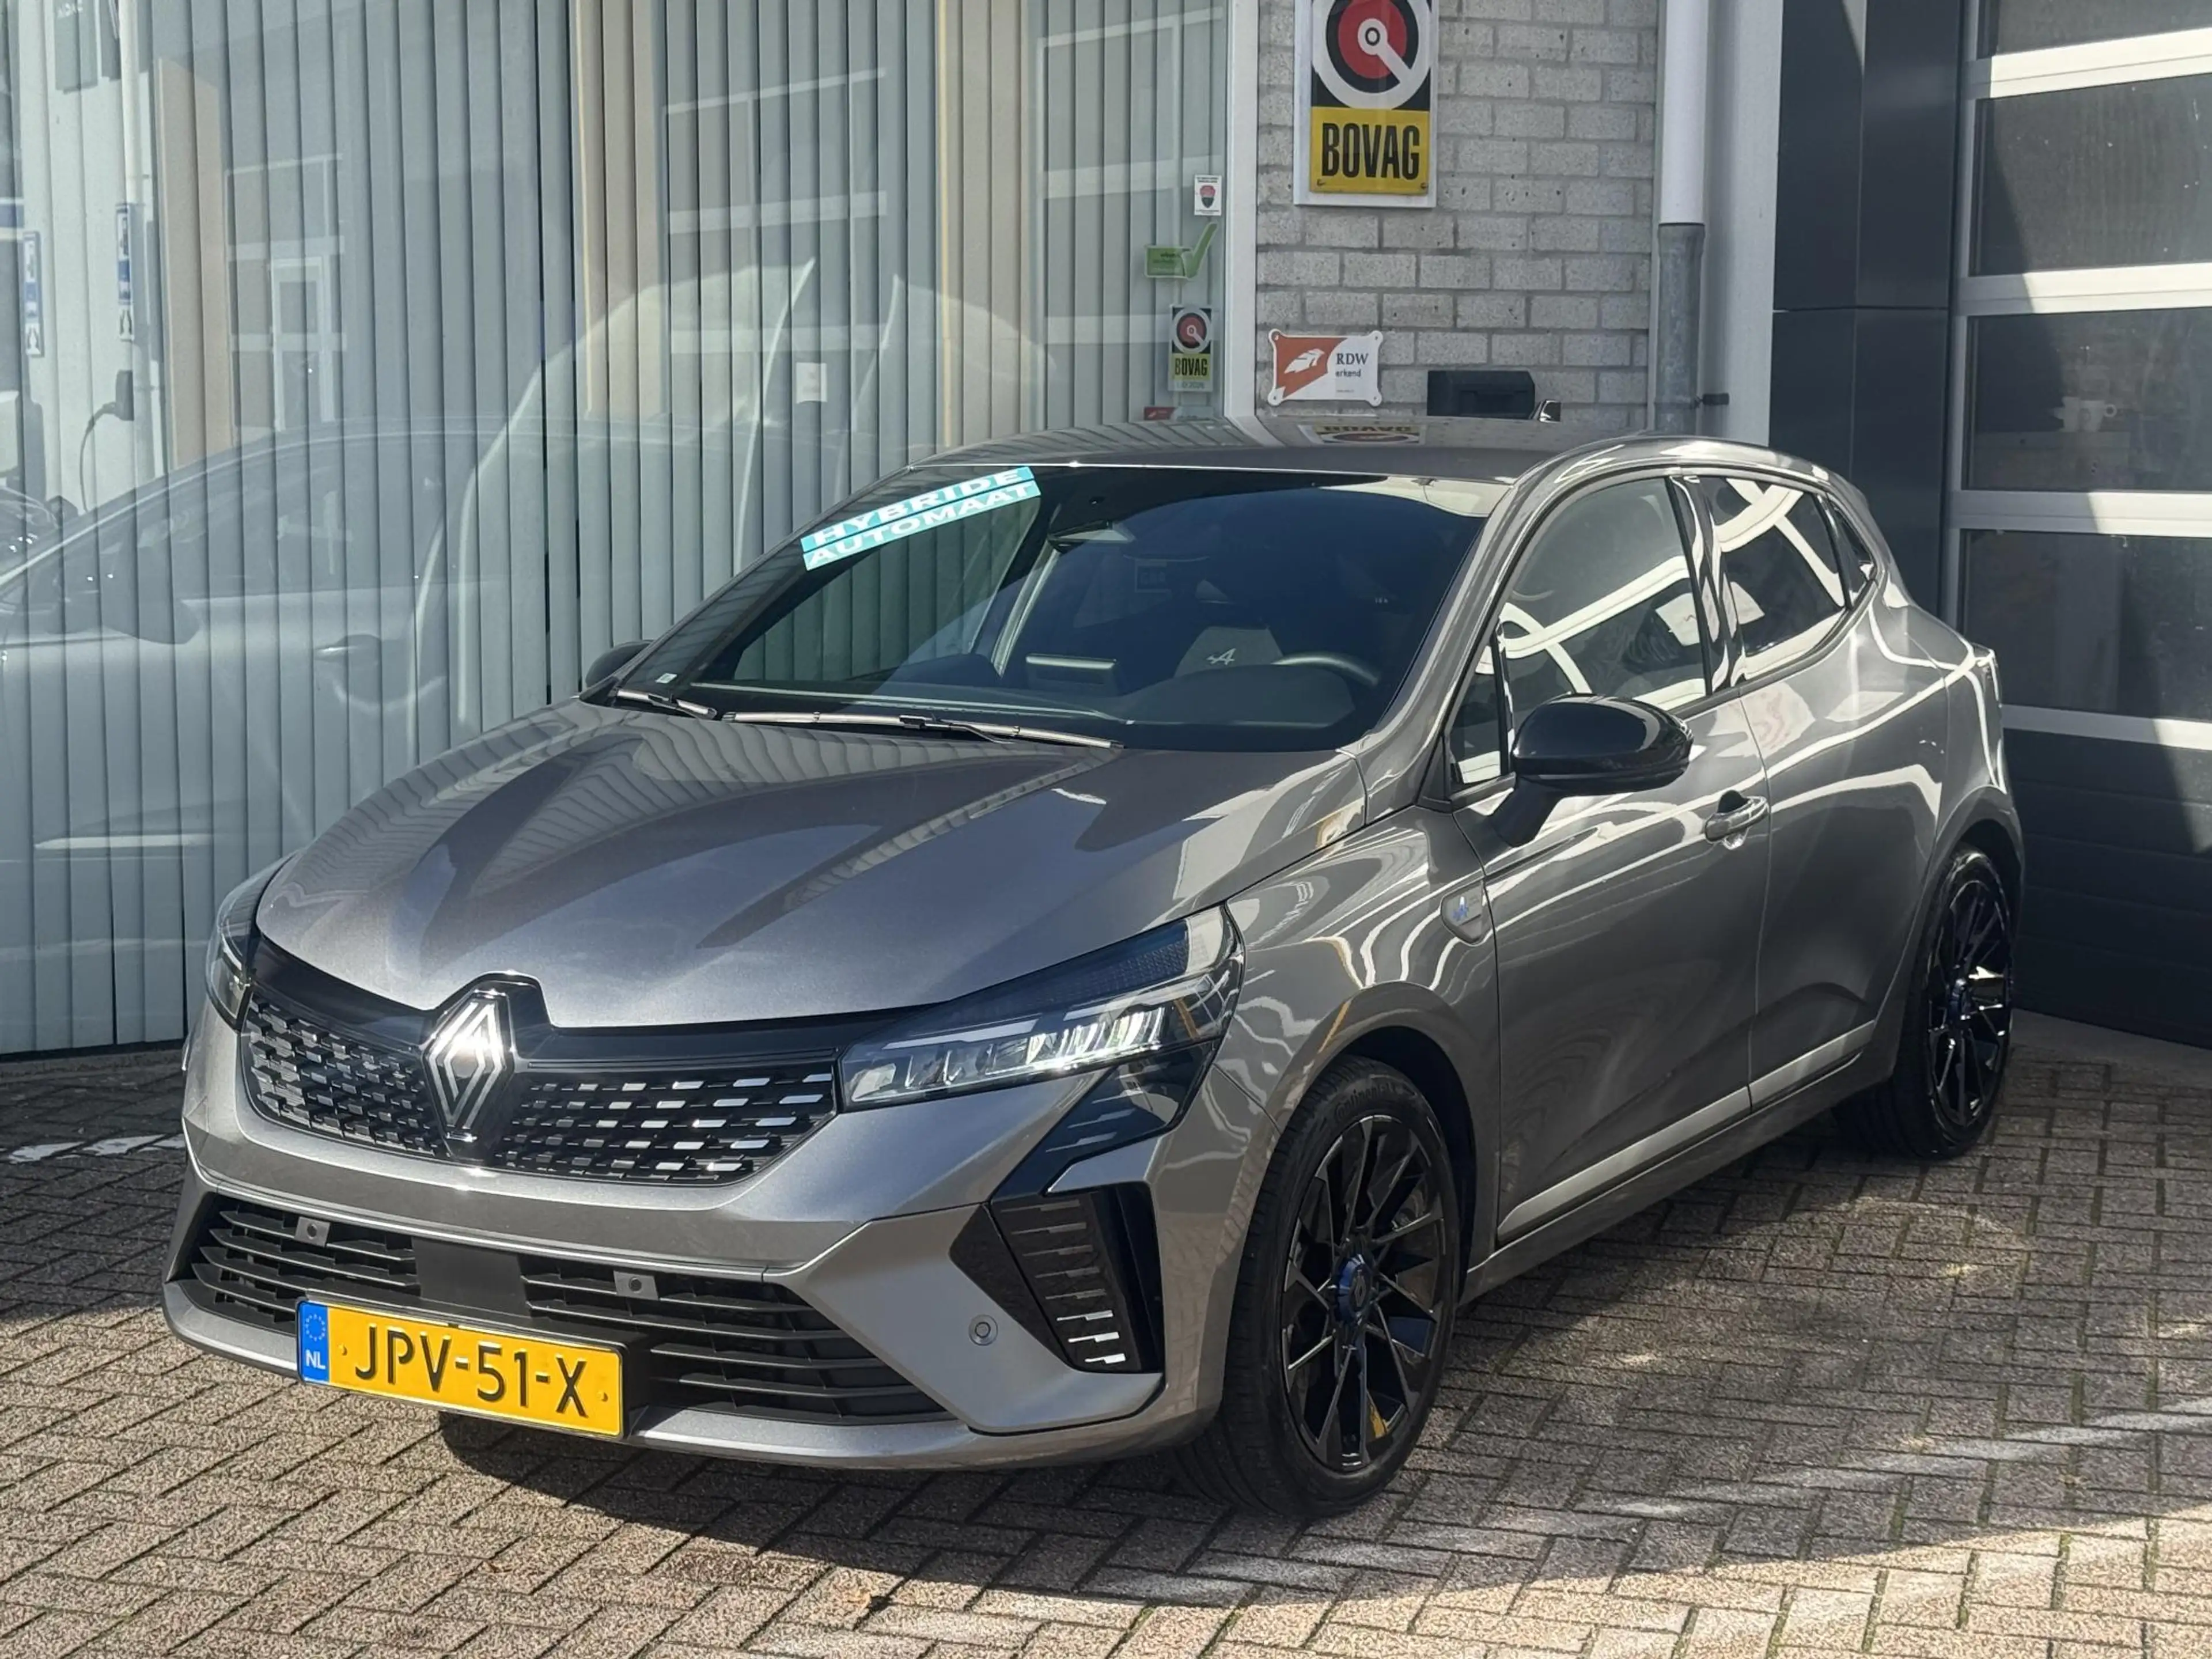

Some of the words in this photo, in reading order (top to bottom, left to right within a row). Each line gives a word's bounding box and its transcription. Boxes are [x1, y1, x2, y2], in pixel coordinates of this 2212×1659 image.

[1321, 123, 1420, 180] BOVAG
[1175, 358, 1207, 376] BOVAG
[1336, 369, 1361, 377] erkend
[1337, 353, 1369, 365] RDW
[810, 485, 1031, 564] AUTOMAAT
[811, 469, 1023, 545] HYBRIDE
[306, 1350, 325, 1370] NL
[355, 1323, 589, 1418] JPV-51-X
